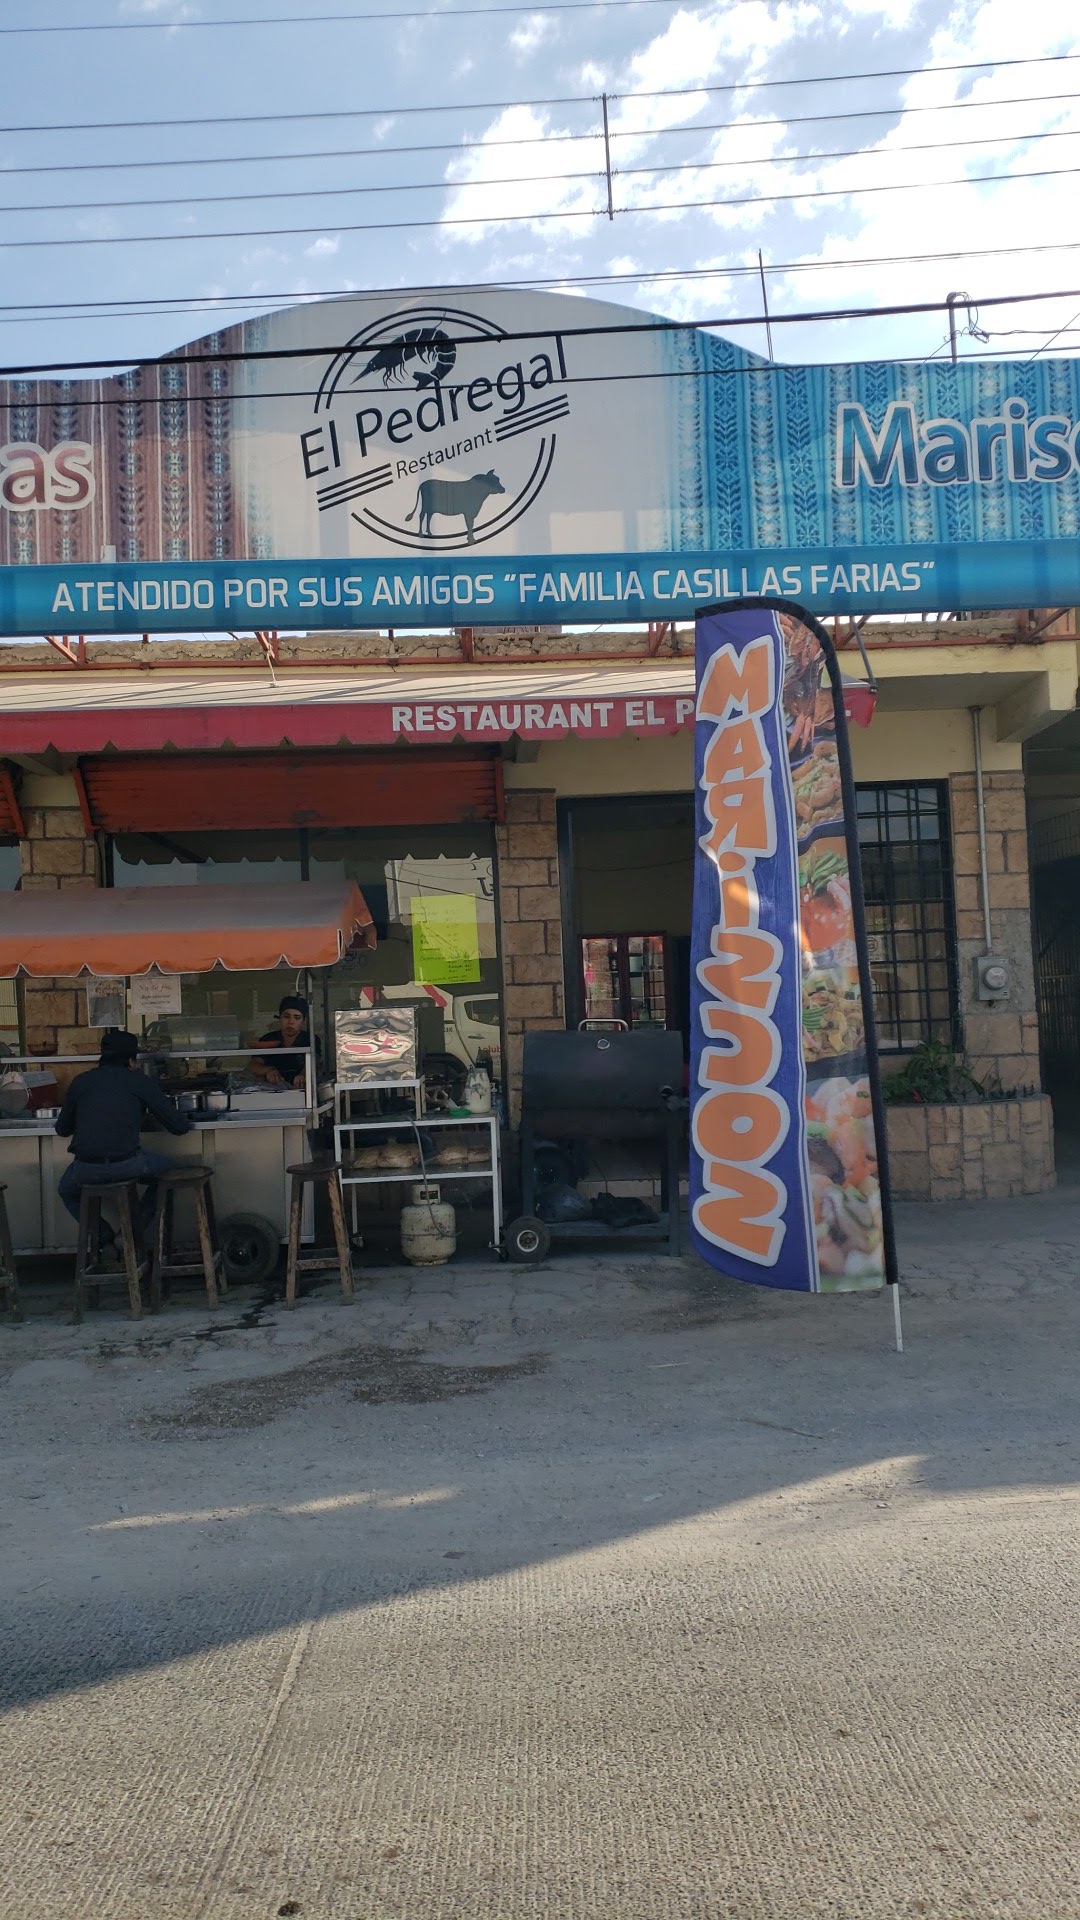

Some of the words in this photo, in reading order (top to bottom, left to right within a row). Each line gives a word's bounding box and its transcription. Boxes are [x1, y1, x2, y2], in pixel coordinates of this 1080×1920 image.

[300, 420, 342, 480] El
[355, 335, 568, 458] Pedregal
[396, 428, 493, 479] Restaurant
[836, 398, 1080, 487] Maris
[52, 580, 214, 612] ATENDIDO
[224, 578, 289, 608] POR
[299, 577, 363, 607] SUS
[371, 574, 495, 606] AMIGOS
[652, 566, 802, 599] CASILLAS
[392, 702, 614, 732] RESTAURANT
[625, 700, 665, 727] EL
